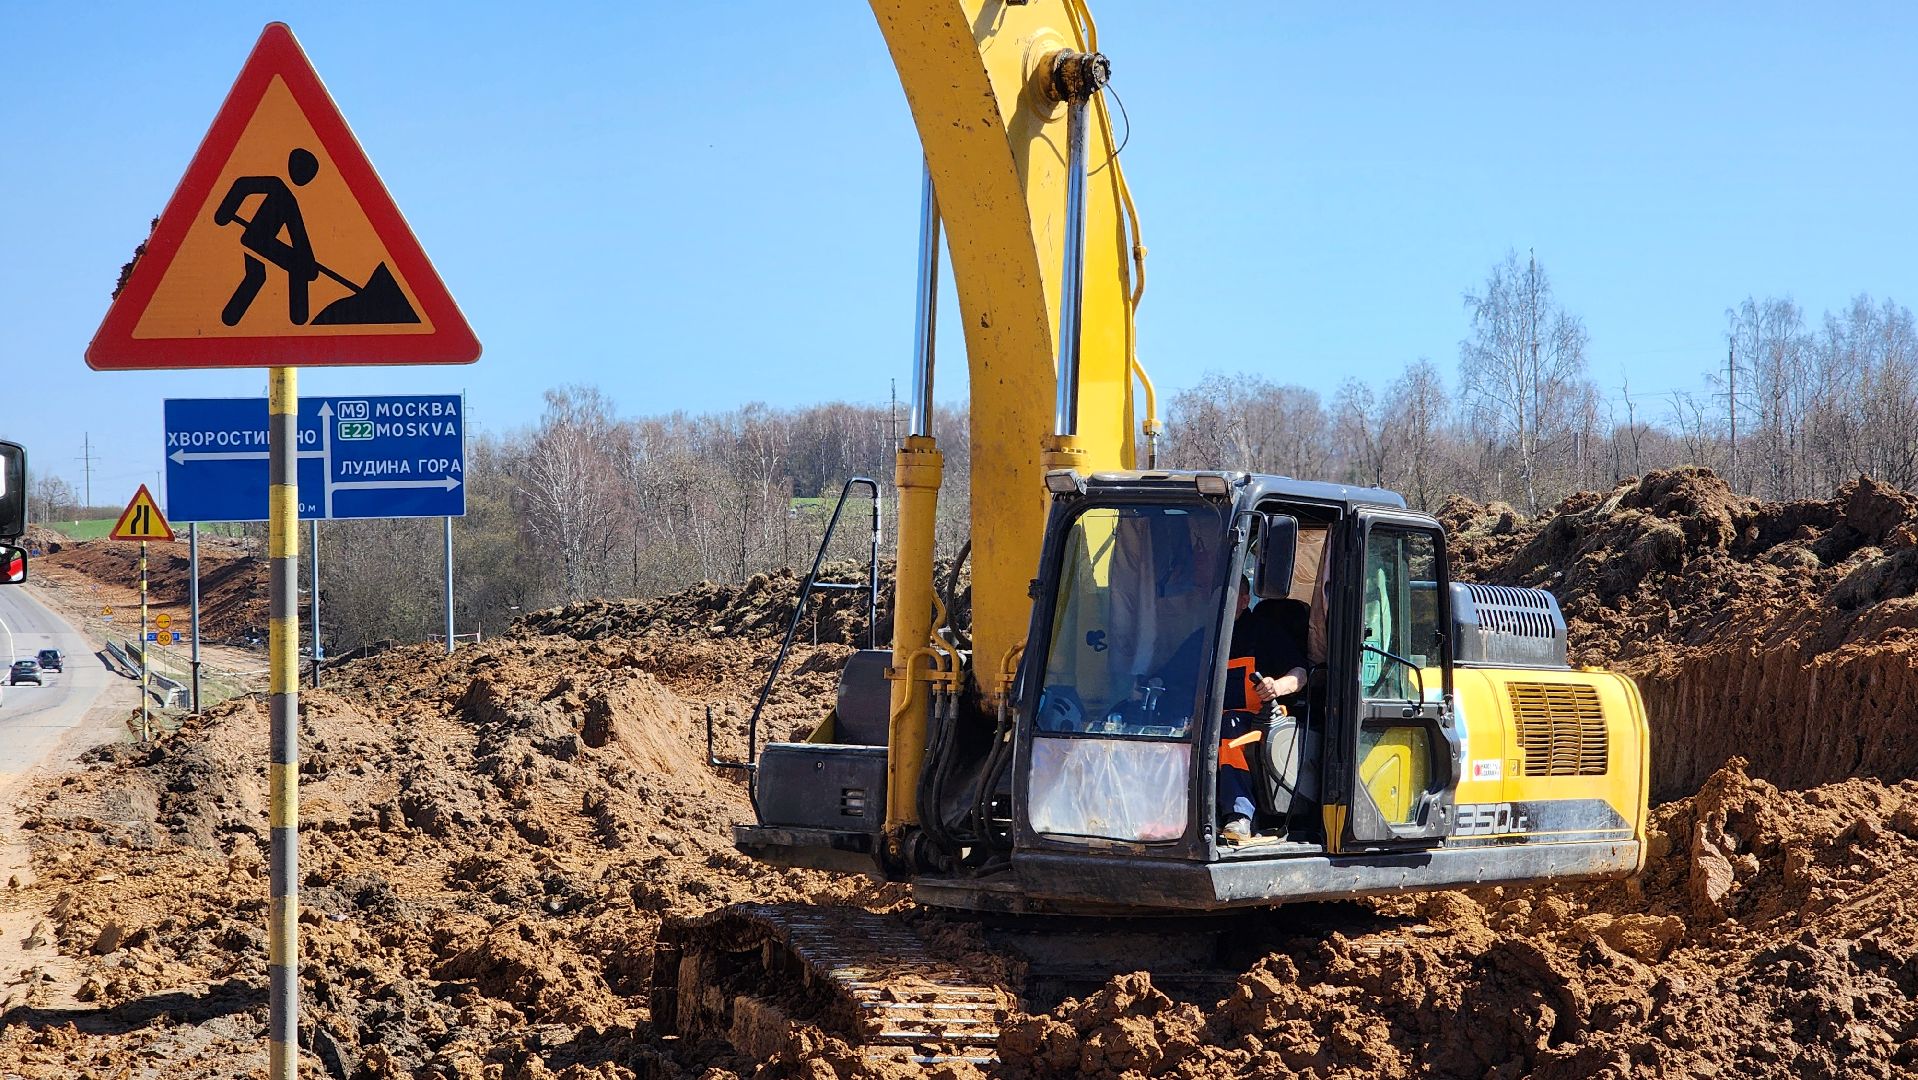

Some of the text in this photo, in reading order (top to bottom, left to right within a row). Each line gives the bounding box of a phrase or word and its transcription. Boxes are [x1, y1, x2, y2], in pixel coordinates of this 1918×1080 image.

[376, 402, 457, 417] МОСКВА
[342, 422, 456, 438] E22 MOSKVA
[168, 430, 317, 447] ХВОРОСТИНО
[340, 459, 462, 476] ЛУДИНА ГОРА
[160, 634, 169, 642] 50
